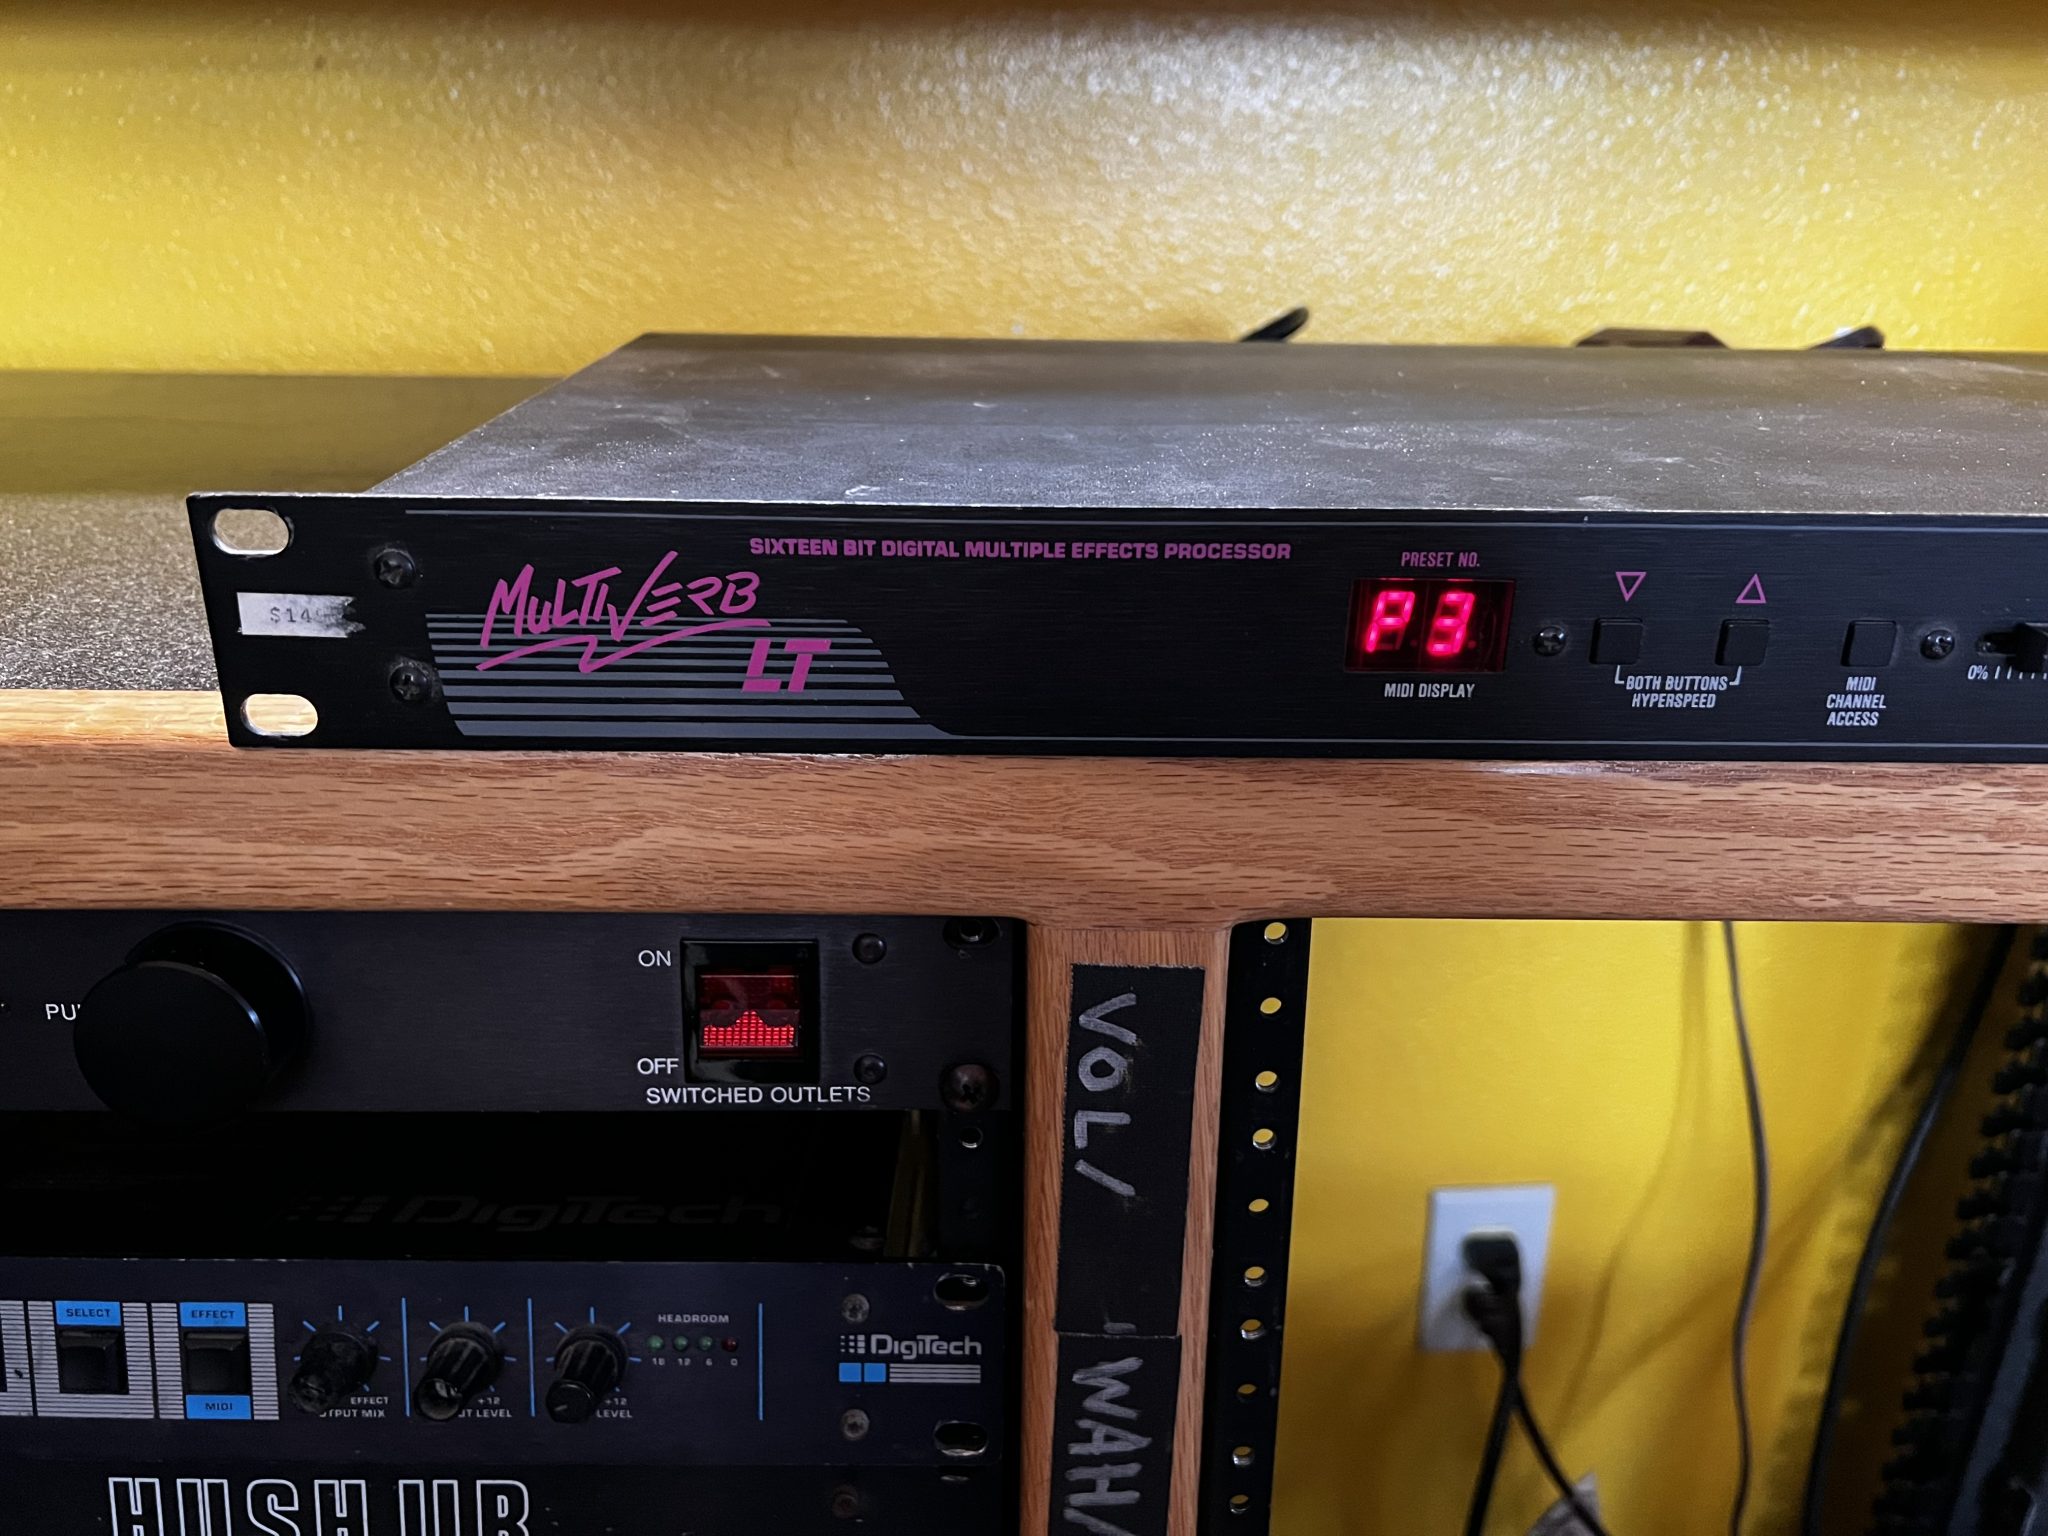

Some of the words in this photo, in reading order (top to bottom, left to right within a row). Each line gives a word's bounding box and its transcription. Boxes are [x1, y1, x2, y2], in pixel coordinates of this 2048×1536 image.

[749, 537, 838, 556] SIXTEEN
[843, 540, 876, 557] BIT
[881, 540, 960, 559] DIGITAL
[965, 541, 1066, 559] MULTIPLE
[1071, 542, 1159, 560] EFFECTS
[1164, 543, 1292, 560] PROCESSOR
[1401, 551, 1453, 567] PRESET
[1458, 552, 1481, 568] NO.
[1365, 591, 1476, 657] P3
[741, 638, 831, 693] LT
[1967, 664, 1989, 680] 0%
[1384, 682, 1414, 698] MIDI
[1418, 683, 1475, 698] DISPLAY
[1626, 675, 1662, 690] BOTH
[1665, 675, 1728, 691] BUTTONS
[1845, 676, 1877, 691] MIDI
[1631, 693, 1717, 708] HYPERSPEED
[1826, 693, 1887, 709] CHANNEL
[1826, 711, 1880, 726] ACCESS
[638, 950, 672, 967] ON
[637, 1057, 680, 1075] OFF
[646, 1087, 763, 1105] SWITCHED
[770, 1086, 871, 1103] OUTLETS
[65, 1308, 111, 1318] SELECT
[191, 1309, 235, 1320] EFFECT
[657, 1314, 730, 1323] HEADROOM
[870, 1333, 983, 1360] DigiTech
[205, 1402, 233, 1412] MIDI
[361, 1409, 386, 1418] MIX
[476, 1409, 512, 1418] LEVEL
[596, 1409, 633, 1419] LEVEL
